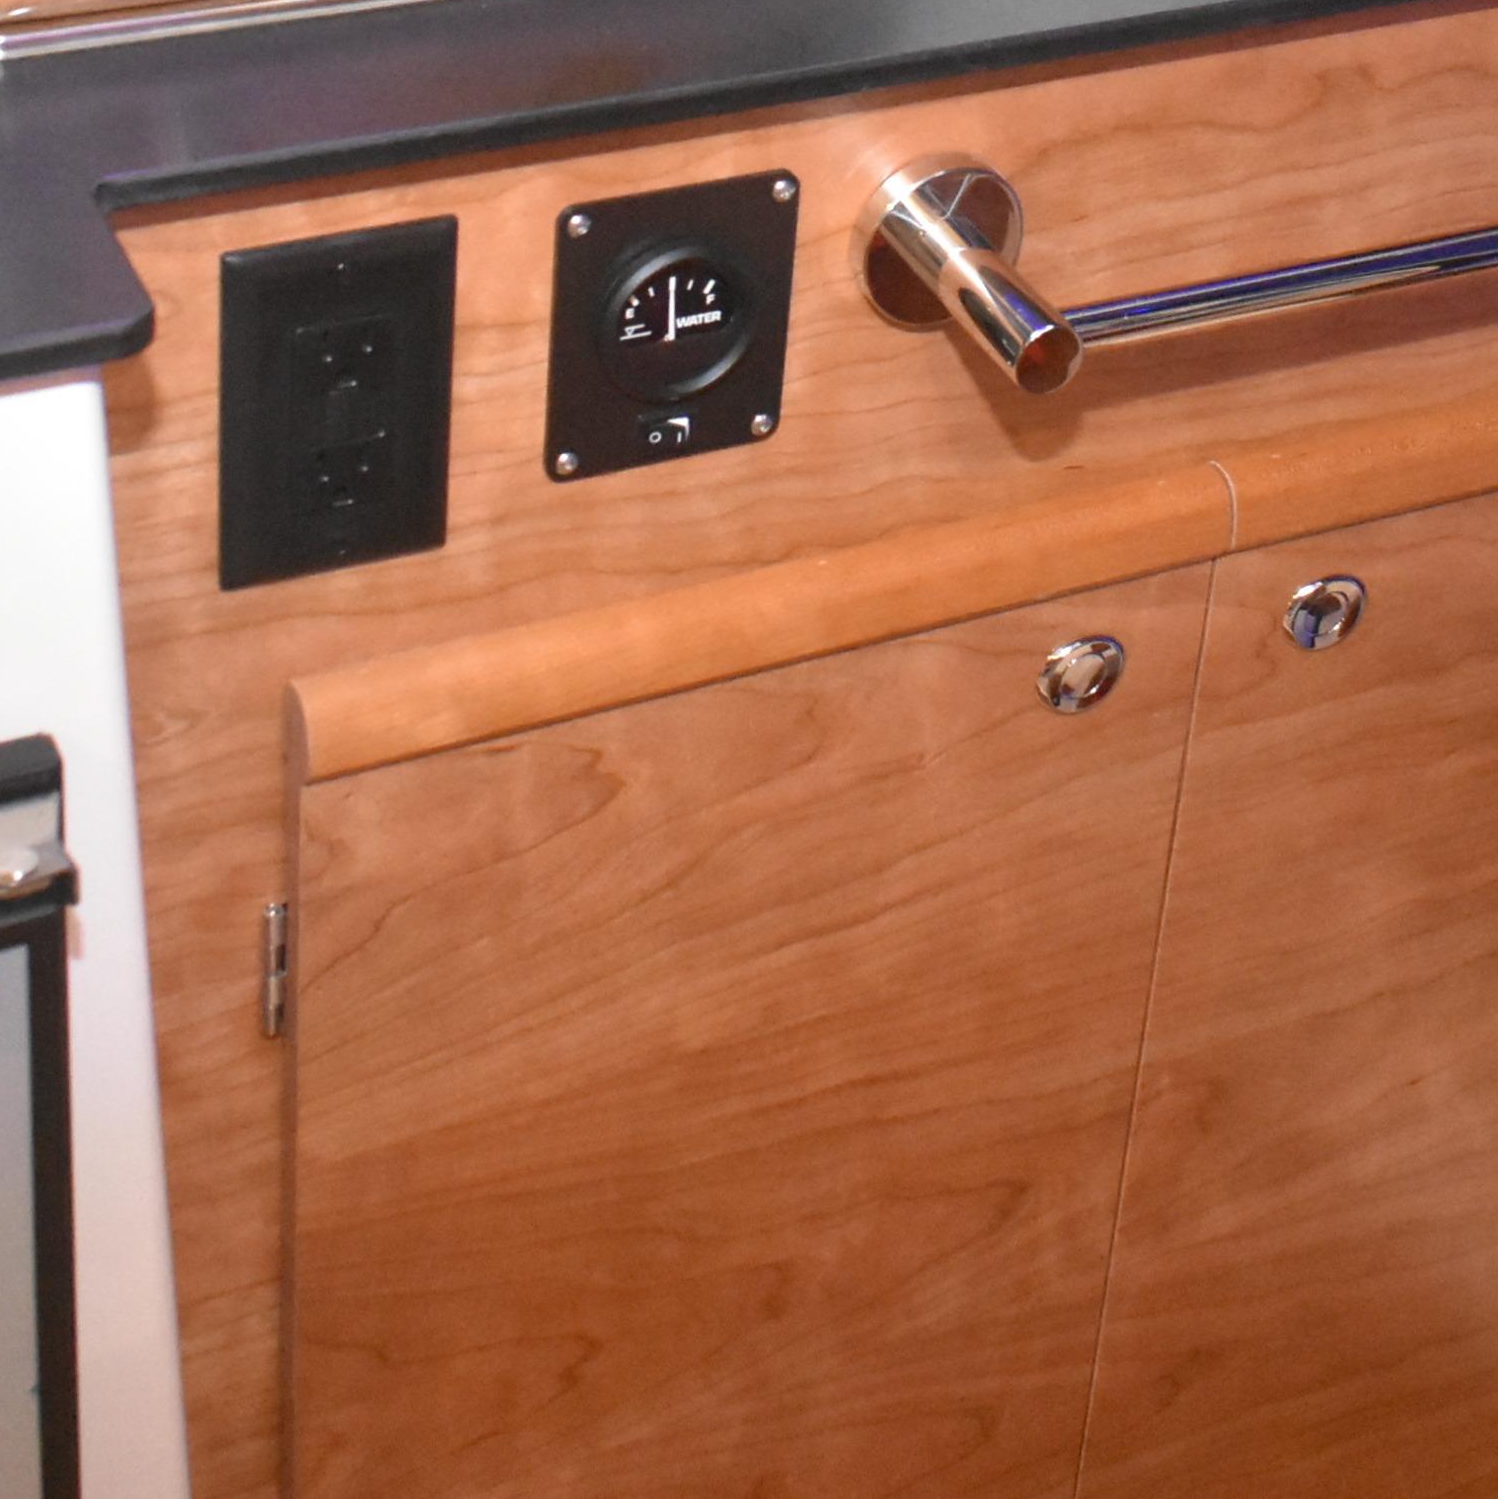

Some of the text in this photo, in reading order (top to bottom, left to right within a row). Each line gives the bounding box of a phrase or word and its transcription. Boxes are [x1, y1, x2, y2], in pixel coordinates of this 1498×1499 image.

[706, 293, 716, 305] F
[625, 307, 635, 320] E
[676, 310, 722, 329] WATER
